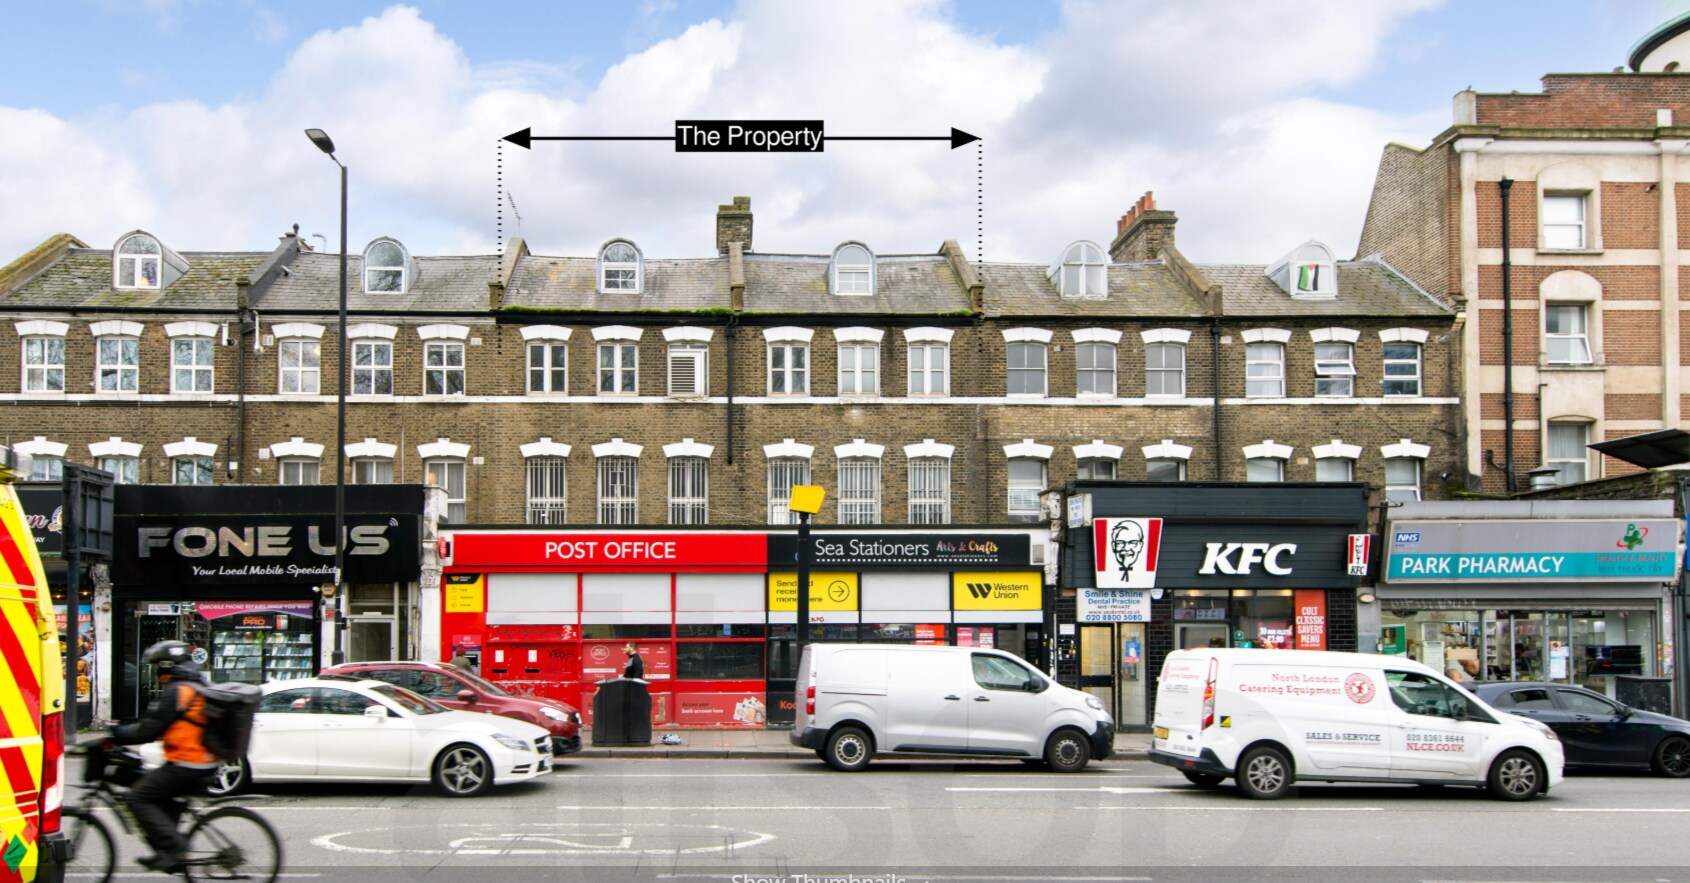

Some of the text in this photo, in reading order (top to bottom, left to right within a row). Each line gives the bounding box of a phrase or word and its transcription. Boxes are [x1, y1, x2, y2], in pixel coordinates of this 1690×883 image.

[138, 525, 390, 558] FONE US
[1397, 533, 1419, 542] NHS
[545, 541, 677, 559] POST OFFICE
[815, 539, 845, 556] Sea
[849, 539, 930, 556] Stationers
[936, 540, 999, 555] Arts & Crafts
[1198, 542, 1297, 576] KFC
[1596, 554, 1667, 562] HEALTH & BEAUTY
[1350, 565, 1365, 575] KFC
[1401, 556, 1565, 574] PARK PHARMACY
[192, 565, 215, 577] Your
[219, 565, 248, 576] Local
[249, 565, 283, 576] Mobile
[993, 583, 1029, 591] Western
[994, 591, 1019, 599] Union
[1084, 590, 1143, 598] Smile & Shine
[1301, 606, 1318, 616] CULT
[1296, 616, 1324, 625] CLASSIC
[1297, 625, 1323, 634] SAVERS
[1300, 634, 1320, 643] MENU
[1271, 674, 1340, 683] North London
[1239, 684, 1341, 696] Catering Equipment
[1306, 732, 1381, 742] SALES & SERVICE
[1406, 733, 1421, 741] 020
